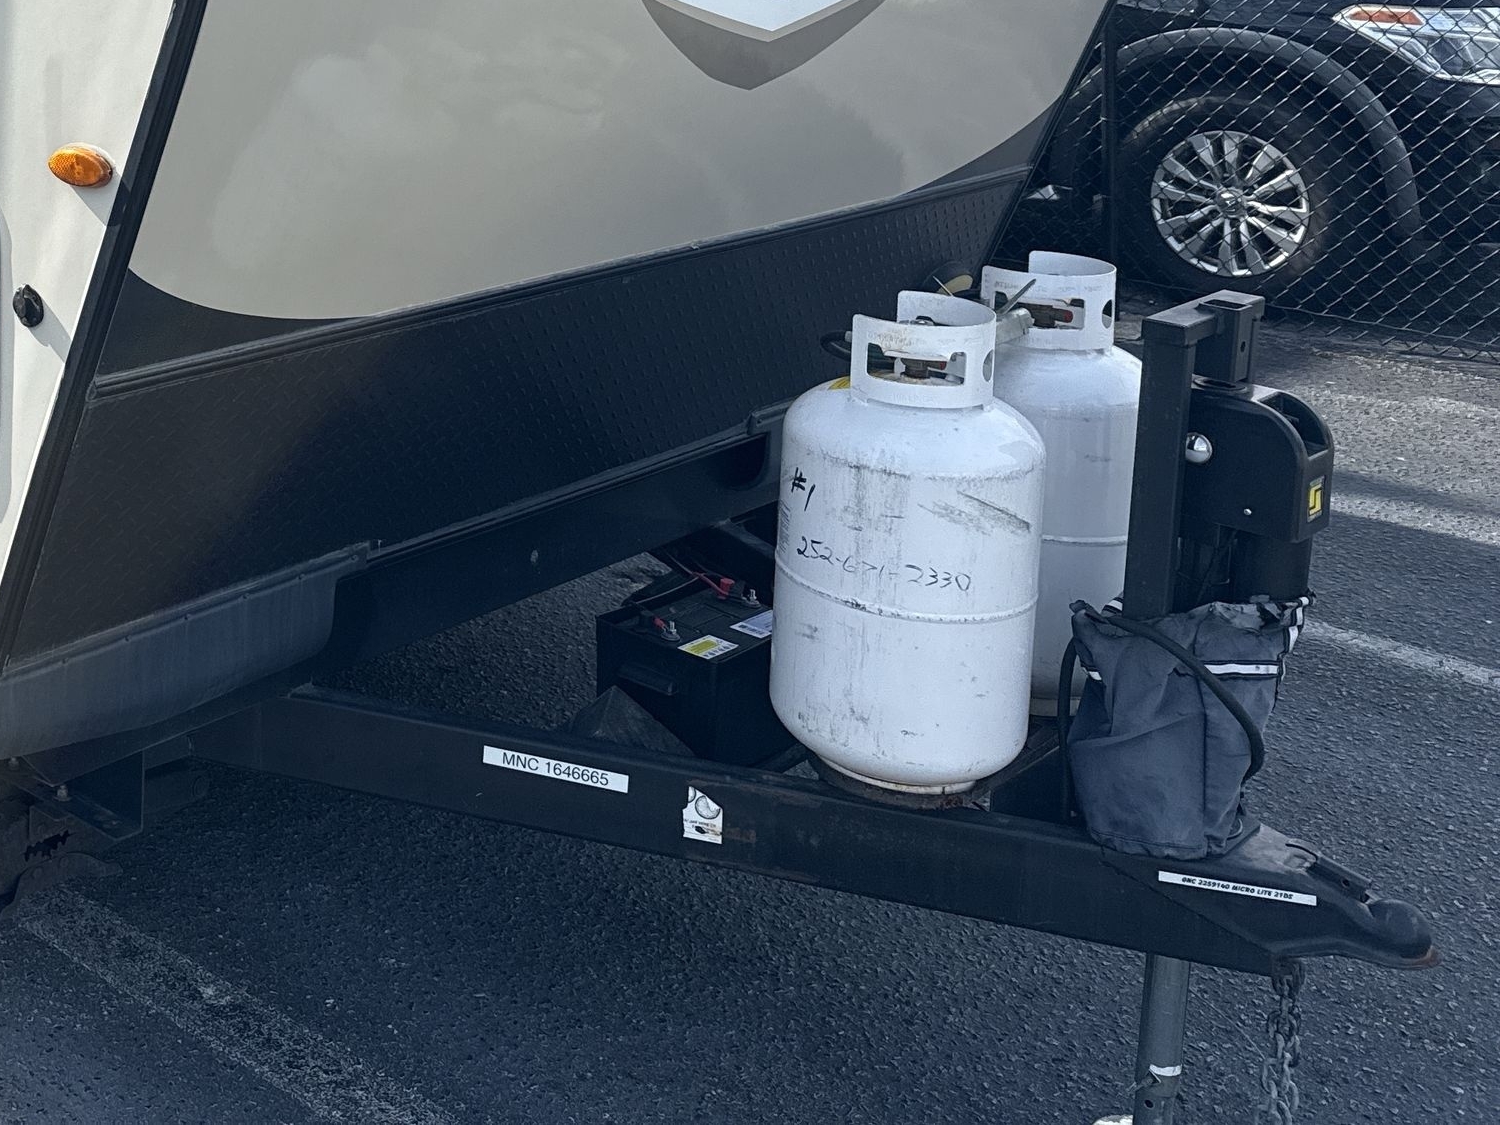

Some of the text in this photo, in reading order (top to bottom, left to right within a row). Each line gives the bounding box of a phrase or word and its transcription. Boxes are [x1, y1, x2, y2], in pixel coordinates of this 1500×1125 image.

[791, 467, 816, 512] #1
[502, 752, 610, 787] MNC 1646665
[1231, 884, 1256, 894] MICRO
[1256, 888, 1273, 897] LITE
